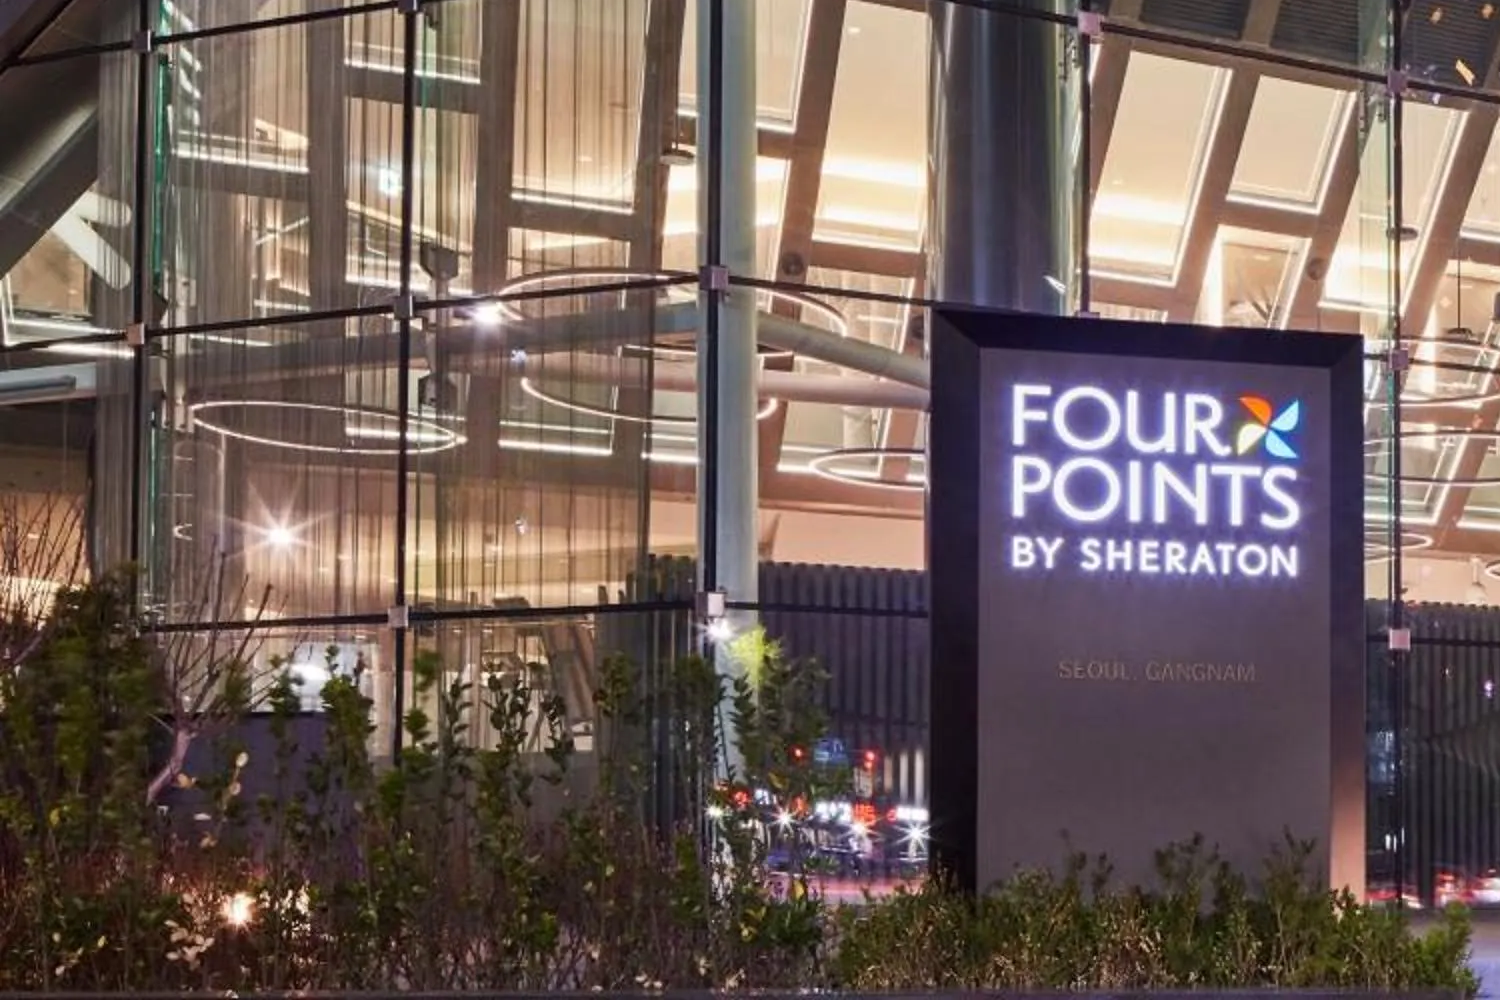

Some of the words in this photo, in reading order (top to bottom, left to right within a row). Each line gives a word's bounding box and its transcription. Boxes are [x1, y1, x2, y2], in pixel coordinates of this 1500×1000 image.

[1011, 383, 1233, 456] FOUR
[1011, 455, 1301, 530] POINTS
[1011, 536, 1064, 570] BY
[1080, 540, 1299, 577] SHERATON
[1144, 659, 1257, 683] GANGNAM
